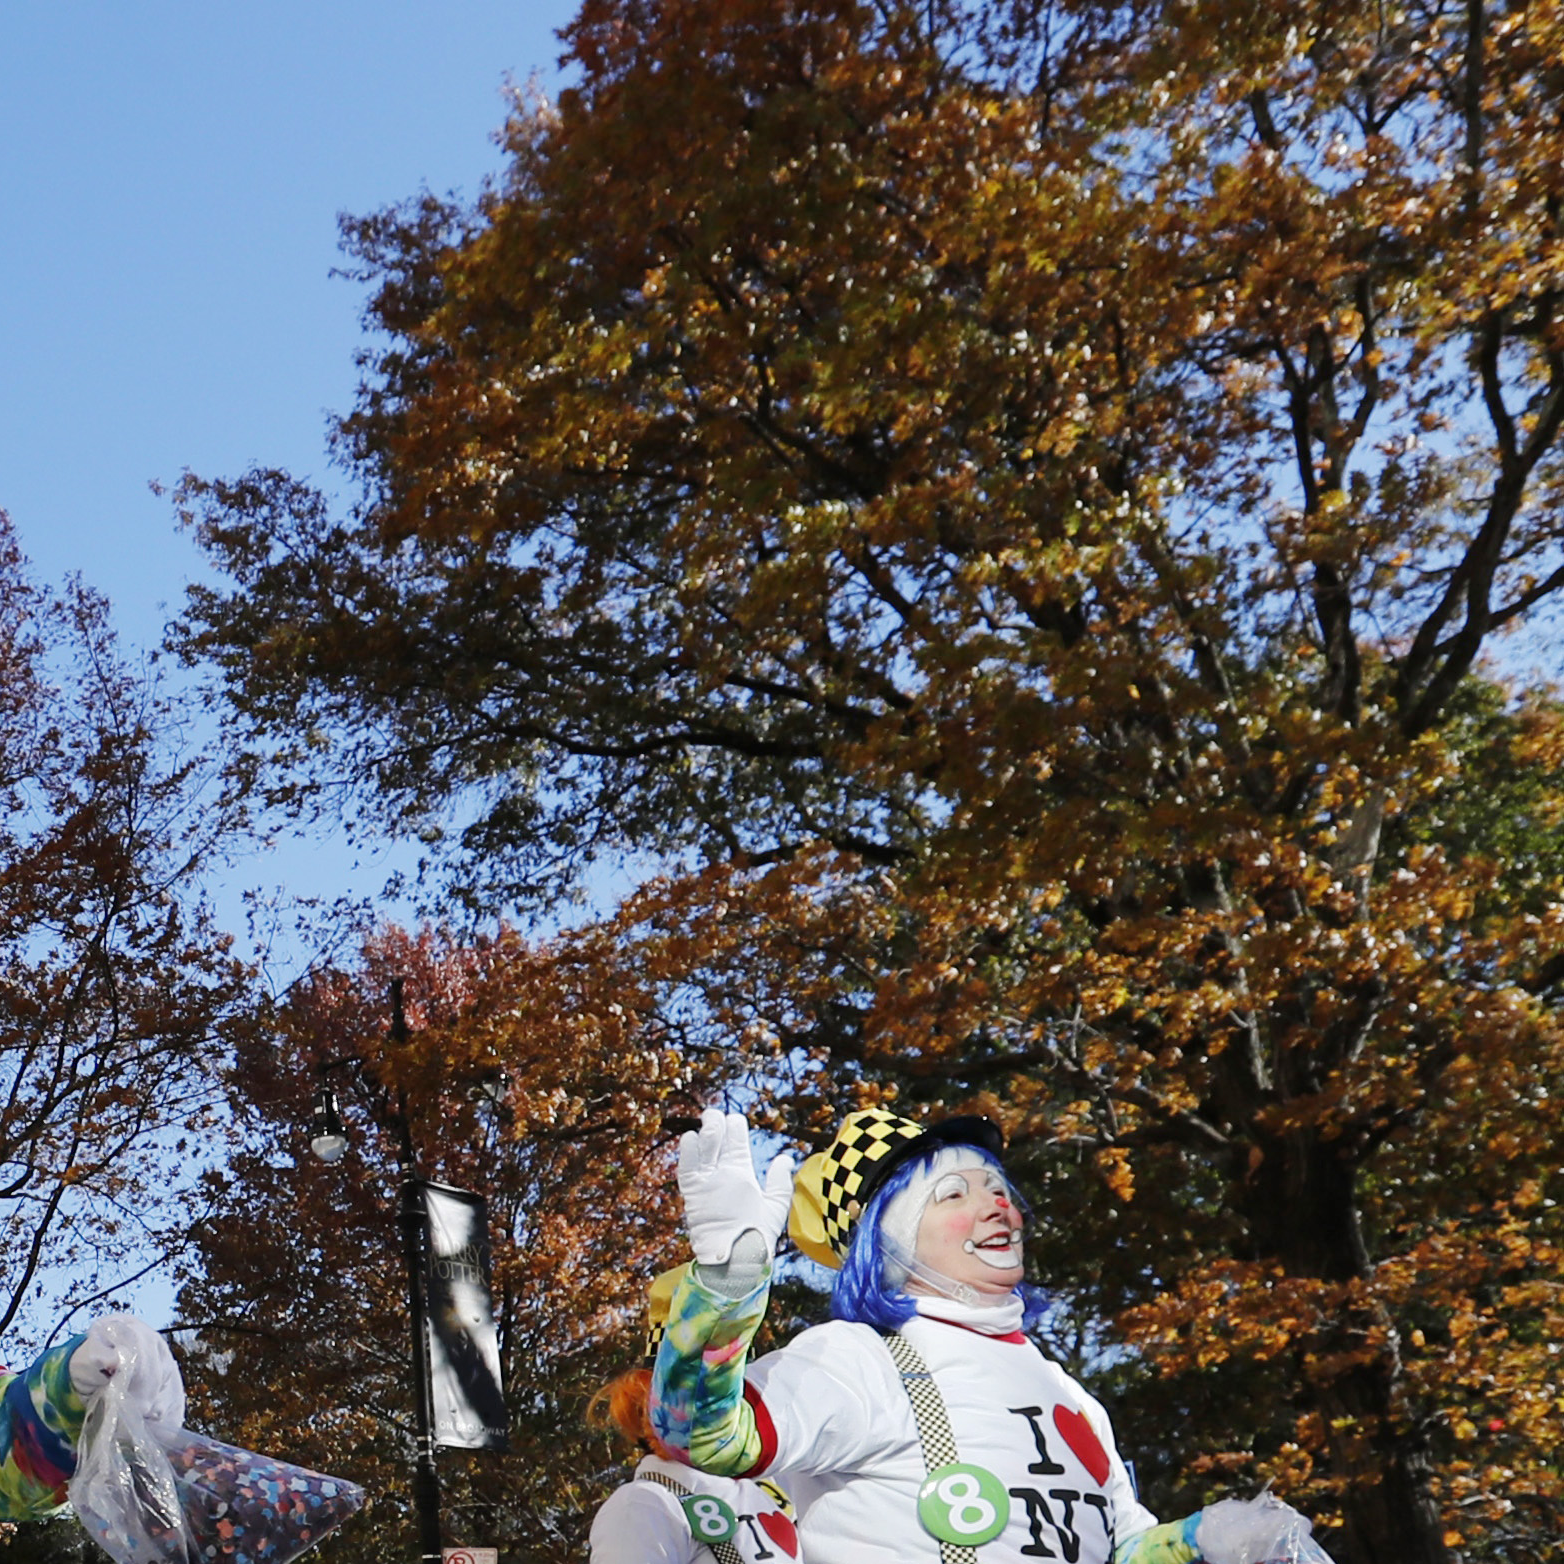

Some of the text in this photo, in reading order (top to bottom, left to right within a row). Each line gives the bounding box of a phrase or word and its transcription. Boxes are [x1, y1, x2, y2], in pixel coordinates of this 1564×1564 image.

[1007, 1406, 1065, 1475] I
[693, 1499, 729, 1536] 8
[938, 1473, 996, 1534] 8
[738, 1514, 774, 1560] I
